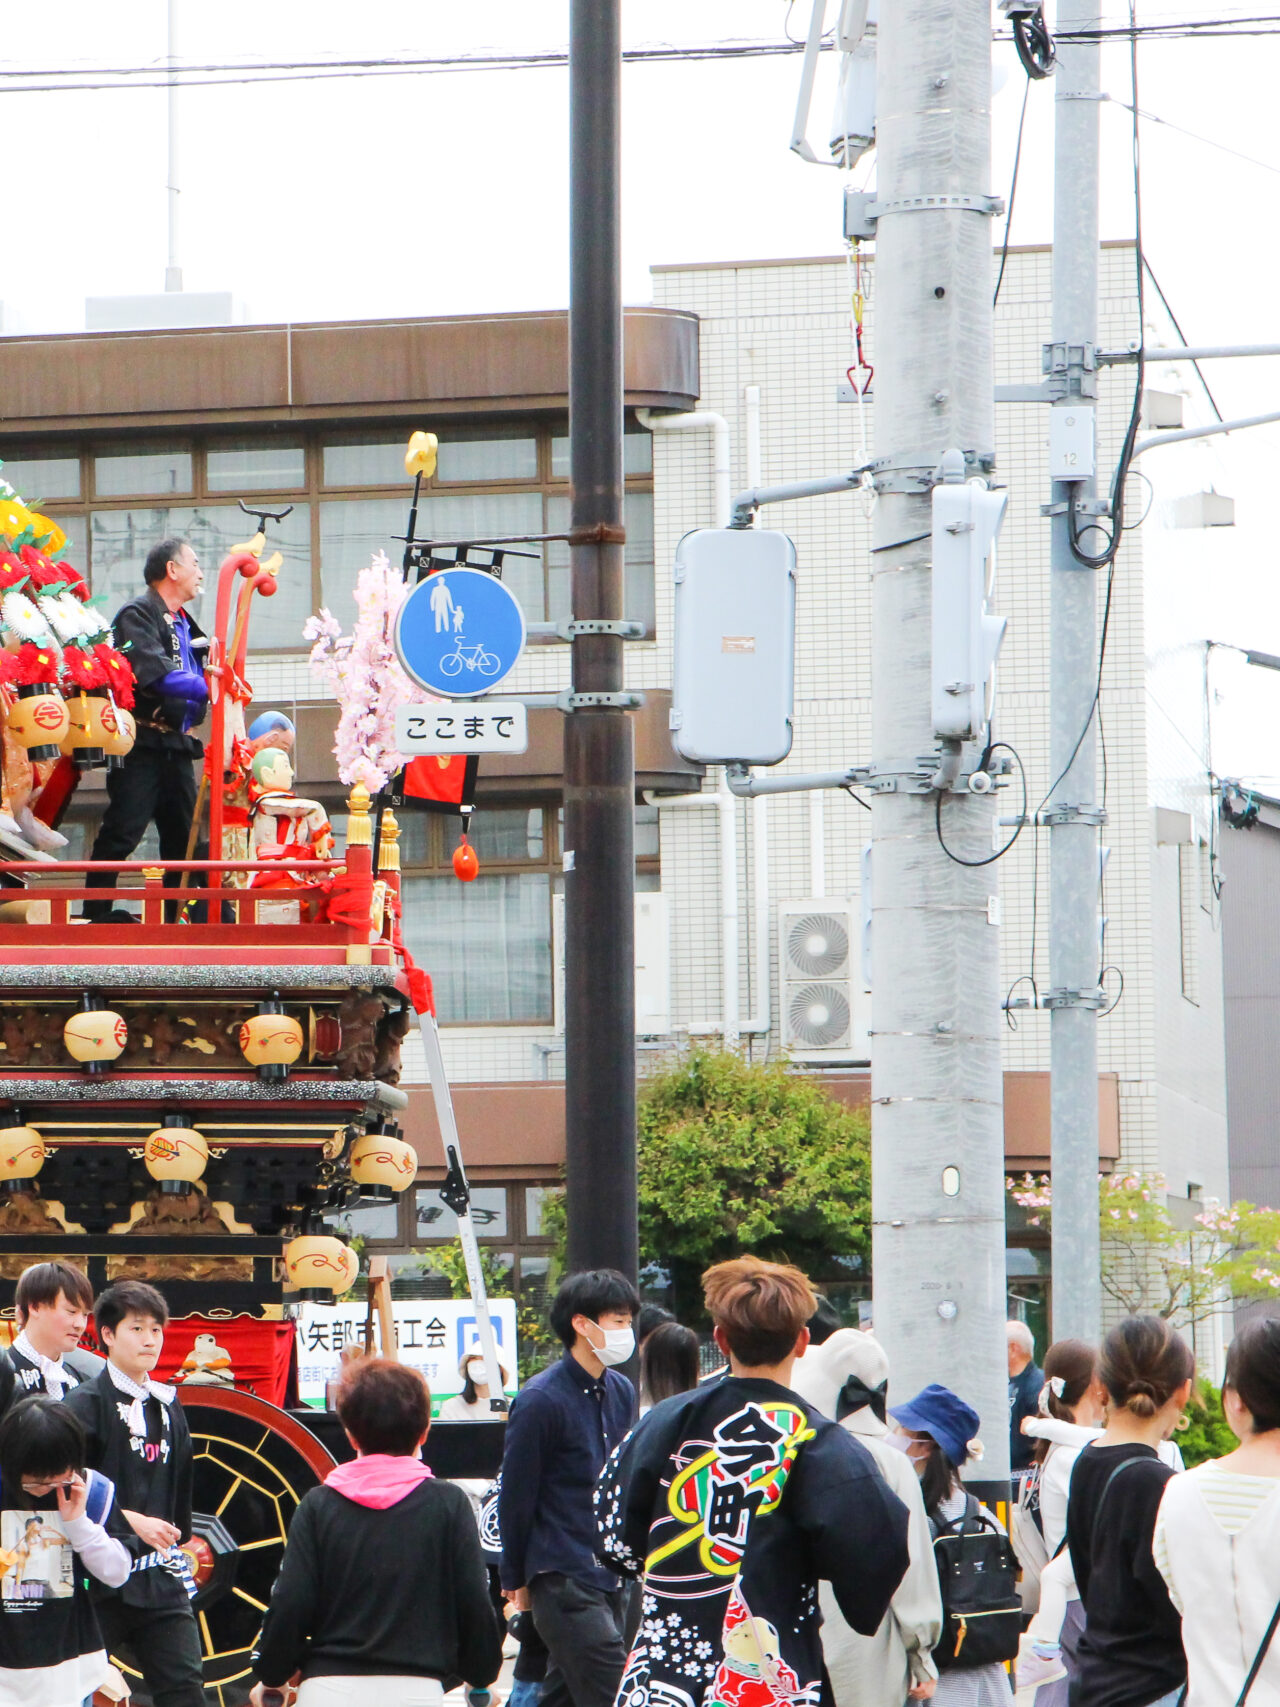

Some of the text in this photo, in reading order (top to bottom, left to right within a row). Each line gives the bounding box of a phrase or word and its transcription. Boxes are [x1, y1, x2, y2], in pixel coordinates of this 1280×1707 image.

[1063, 452, 1077, 466] 12
[406, 715, 514, 739] ここまで
